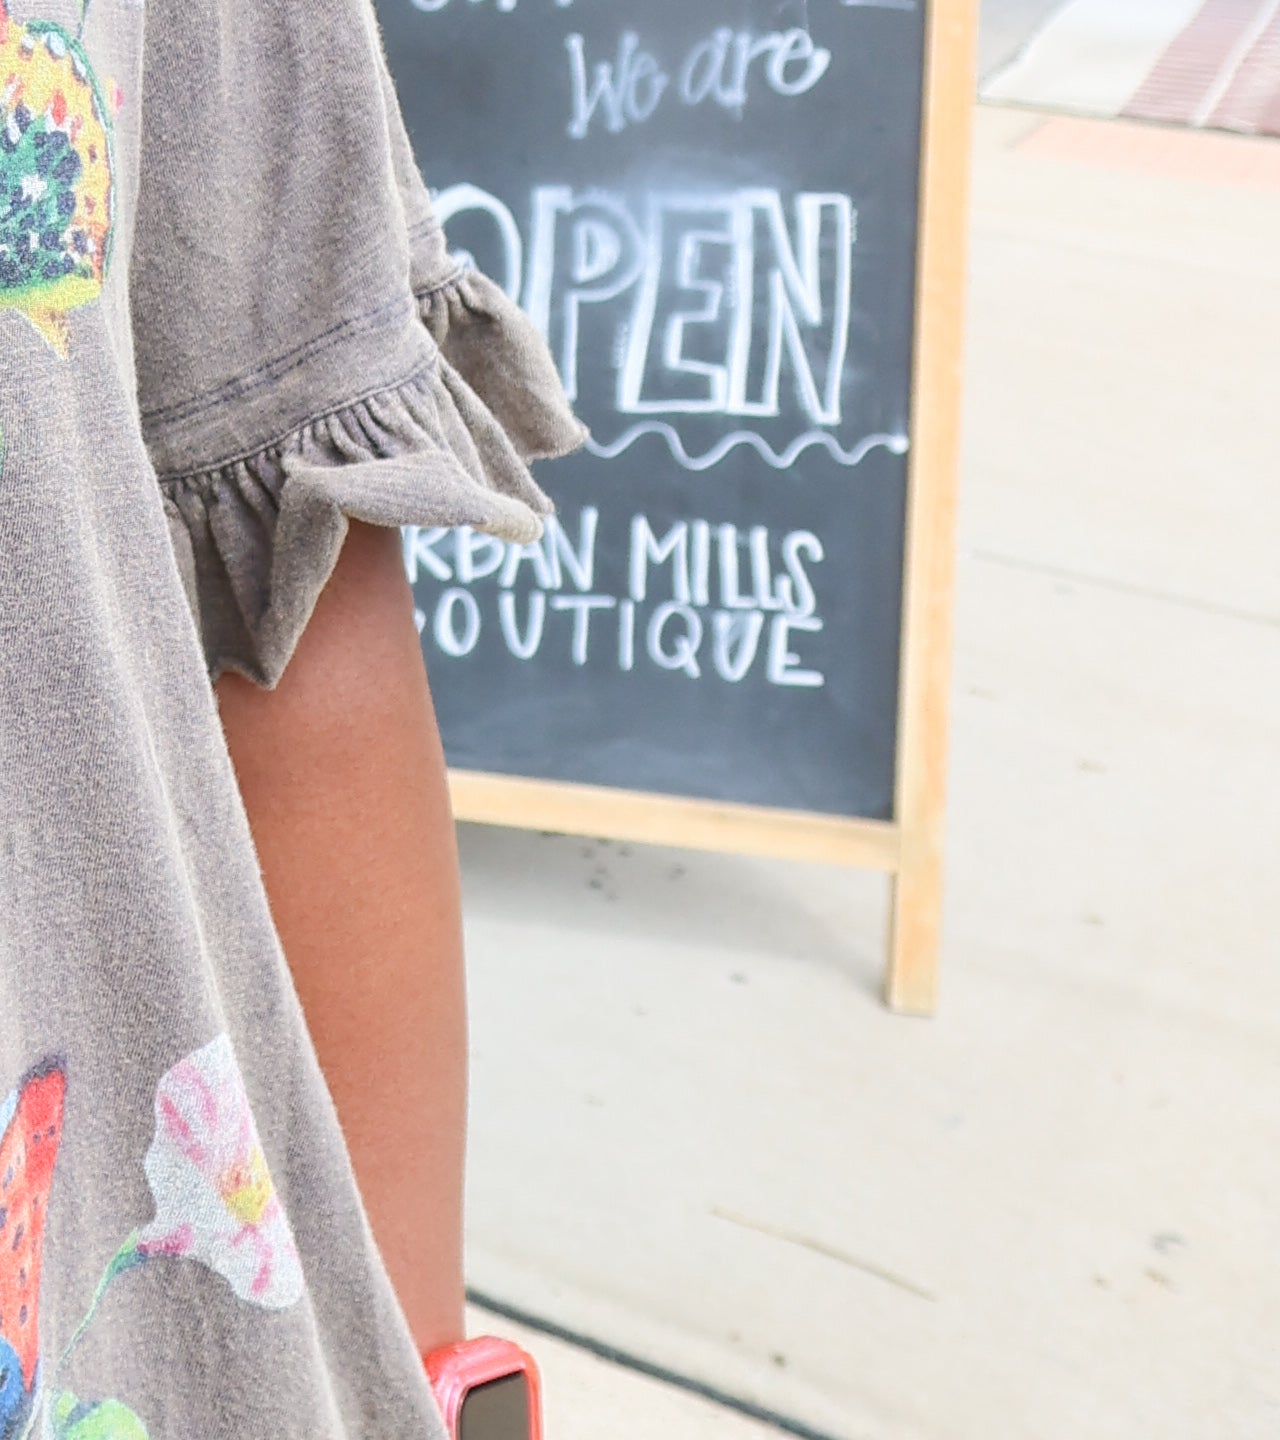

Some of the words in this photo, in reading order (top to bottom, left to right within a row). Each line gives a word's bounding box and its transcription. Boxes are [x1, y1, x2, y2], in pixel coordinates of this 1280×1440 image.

[679, 26, 831, 108] are
[401, 506, 598, 591] RBAN
[628, 514, 825, 618] MILLS
[413, 586, 825, 687] OUTIQUE
